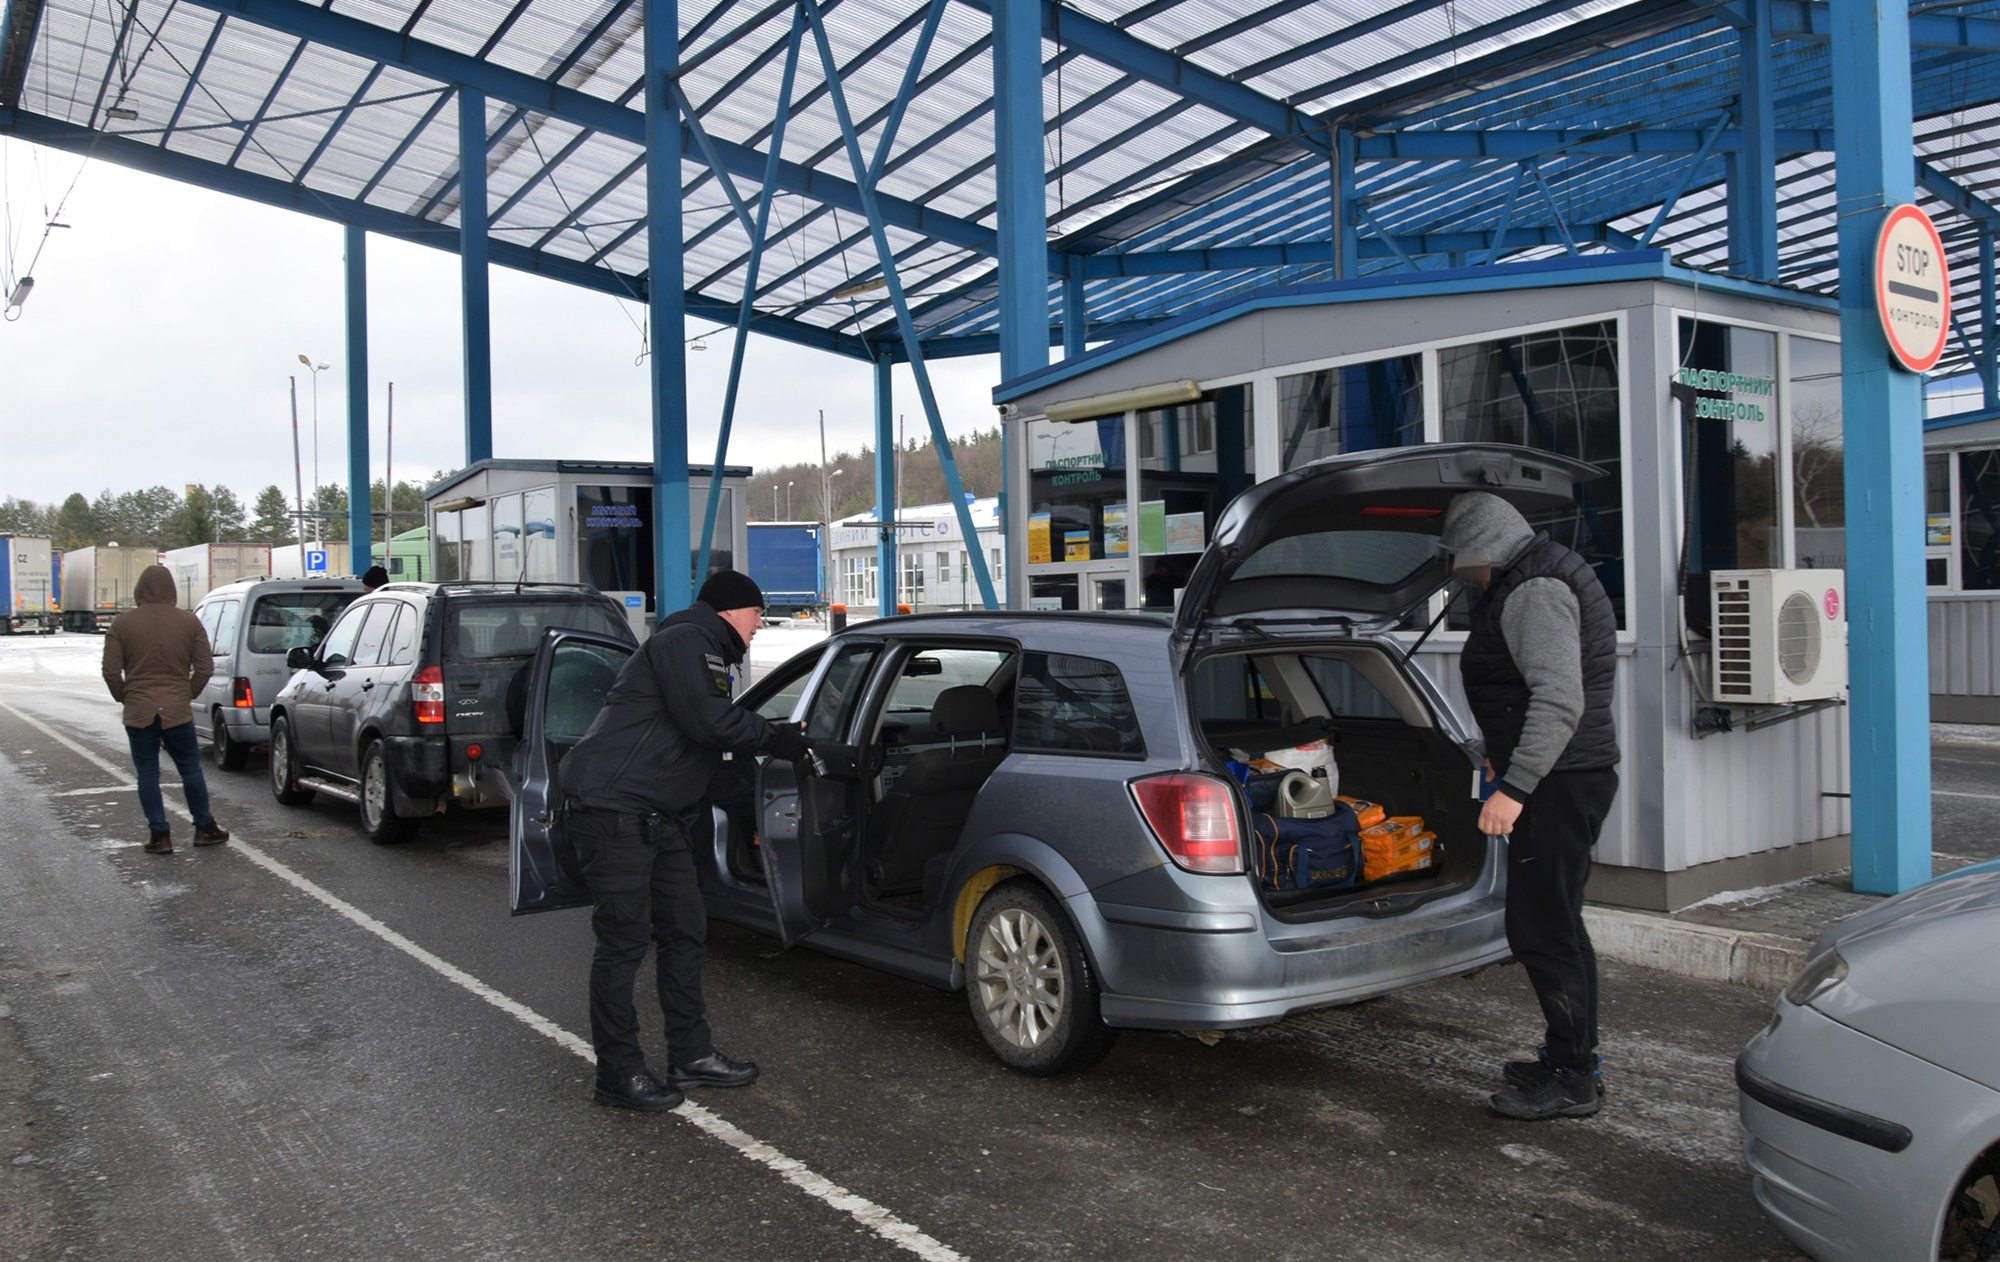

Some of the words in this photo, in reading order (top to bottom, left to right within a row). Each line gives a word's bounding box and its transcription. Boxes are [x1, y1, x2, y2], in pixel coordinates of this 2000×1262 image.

[1897, 243, 1929, 277] STOP
[1680, 367, 1773, 396] ПАСПОРТНИЙ
[1045, 453, 1109, 470] ПАСПОРТНИЙ
[1052, 470, 1102, 486] КОНТРОЛЬ
[586, 517, 643, 528] КОНТРОЛЬ
[17, 553, 28, 564] CZ
[311, 553, 323, 569] P
